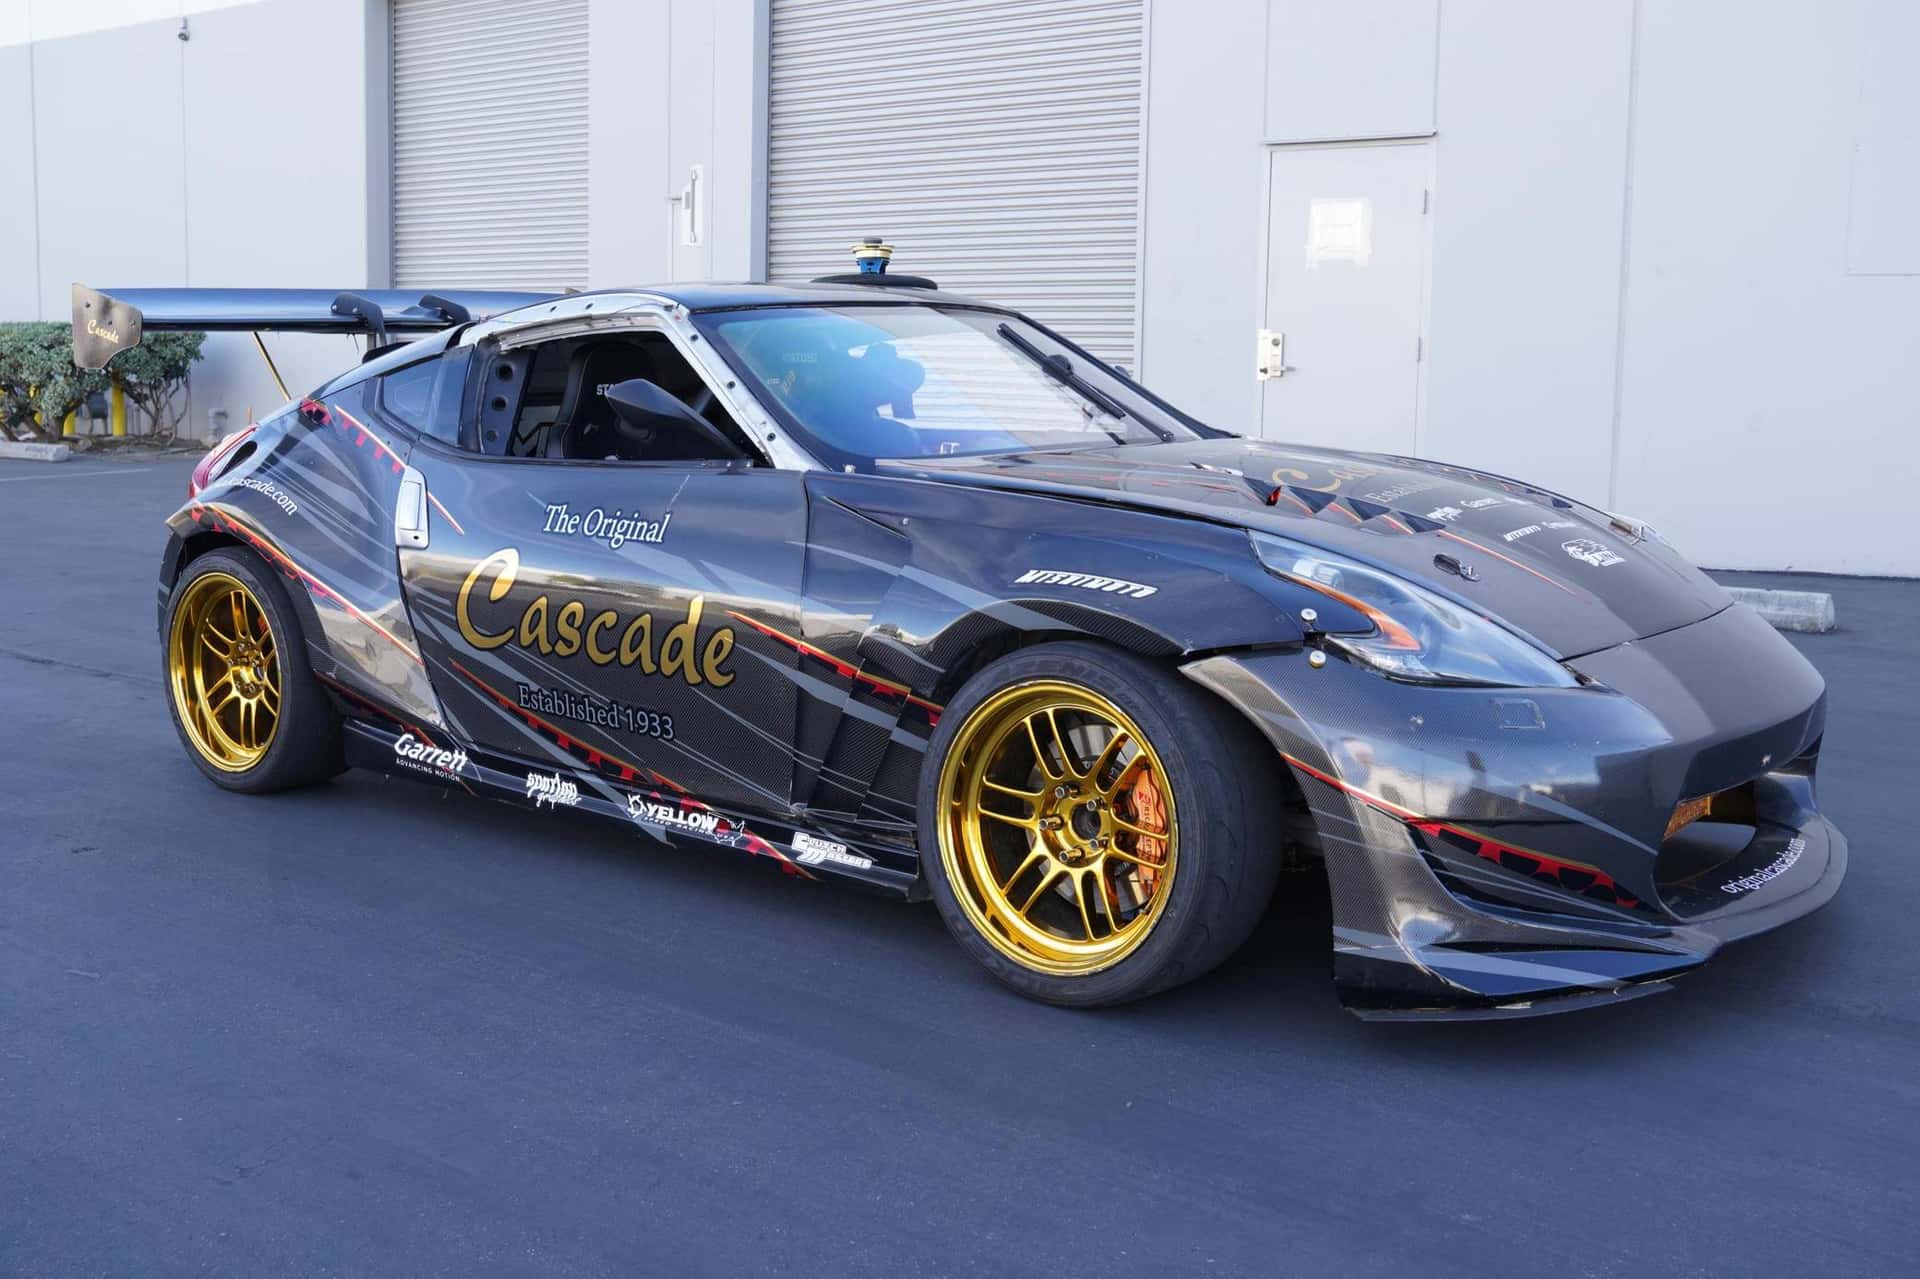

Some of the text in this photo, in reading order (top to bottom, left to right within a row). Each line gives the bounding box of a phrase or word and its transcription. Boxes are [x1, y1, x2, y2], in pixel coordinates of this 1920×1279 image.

[543, 504, 671, 548] The Original
[456, 548, 736, 687] Cascade
[518, 684, 674, 739] Established 1933
[394, 733, 468, 771] Garrett
[395, 757, 460, 782] ADVANCING MOTION
[646, 802, 719, 831] YELLOW
